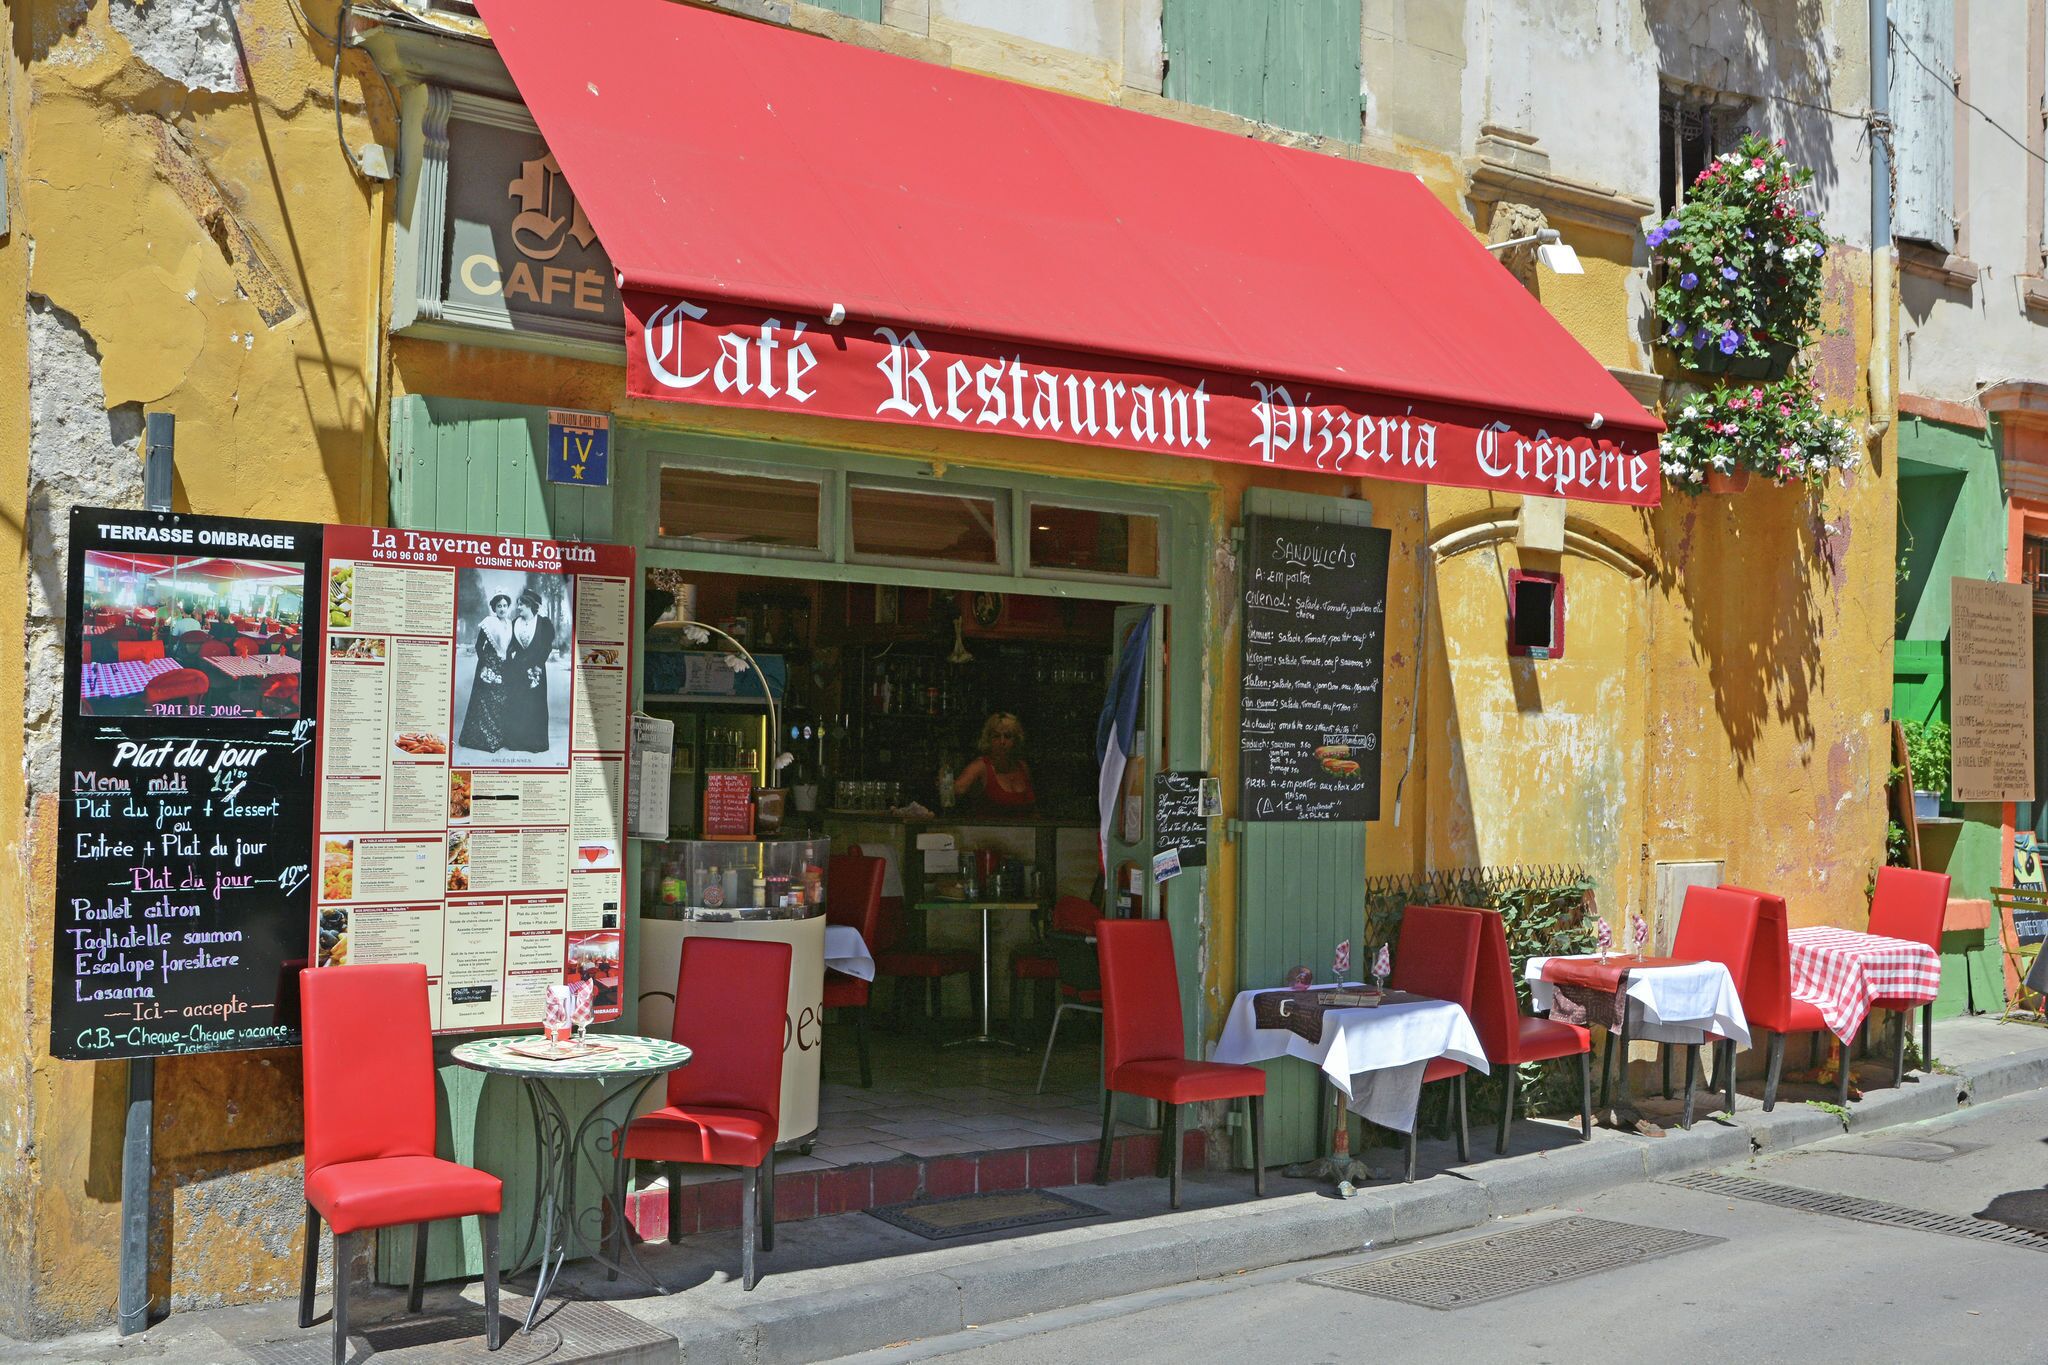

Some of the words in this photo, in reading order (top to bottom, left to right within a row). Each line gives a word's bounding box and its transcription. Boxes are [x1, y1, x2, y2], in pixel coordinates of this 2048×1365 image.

[460, 254, 605, 313] CAFÉ
[644, 300, 820, 403] Café
[874, 326, 1212, 449] Restaurant
[1249, 380, 1438, 471] Pizzeria
[1475, 420, 1649, 494] Crêperie
[557, 412, 577, 425] UNION
[563, 436, 593, 463] IV
[98, 524, 193, 543] TERRASSE
[198, 530, 295, 549] OMBRAGEE
[372, 530, 396, 548] La
[404, 531, 491, 554] Taverne
[499, 538, 524, 558] du
[531, 541, 597, 562] Forum
[372, 549, 384, 558] 04
[386, 550, 397, 559] 90
[399, 551, 411, 560] 96
[413, 551, 424, 561] 08
[426, 552, 437, 562] 80
[475, 556, 512, 568] CUISINE
[514, 559, 561, 570] NON-STOP
[152, 704, 183, 716] PLAT
[189, 705, 205, 716] DE
[210, 704, 241, 716] JOUR
[113, 741, 173, 767] Plat
[174, 740, 208, 767] du
[208, 743, 267, 773] jour
[72, 770, 131, 792] Menu
[149, 772, 188, 791] midi
[76, 798, 111, 818] Plat
[123, 798, 148, 817] du
[156, 800, 192, 829] jour
[223, 798, 279, 817] dessert
[174, 821, 192, 833] ou
[76, 833, 133, 858] Entrée
[210, 834, 228, 856] du
[236, 838, 267, 867] jour
[129, 866, 174, 890] Plat
[180, 865, 206, 888] du
[213, 871, 253, 899] jour
[72, 896, 132, 921] Poulet
[144, 895, 201, 918] citron
[66, 924, 172, 960] Tagliatelle
[184, 930, 242, 943] saumon
[76, 952, 154, 981] Escalope
[161, 948, 239, 984] forestiere
[133, 1002, 162, 1021] Ici
[183, 994, 248, 1021] accepte
